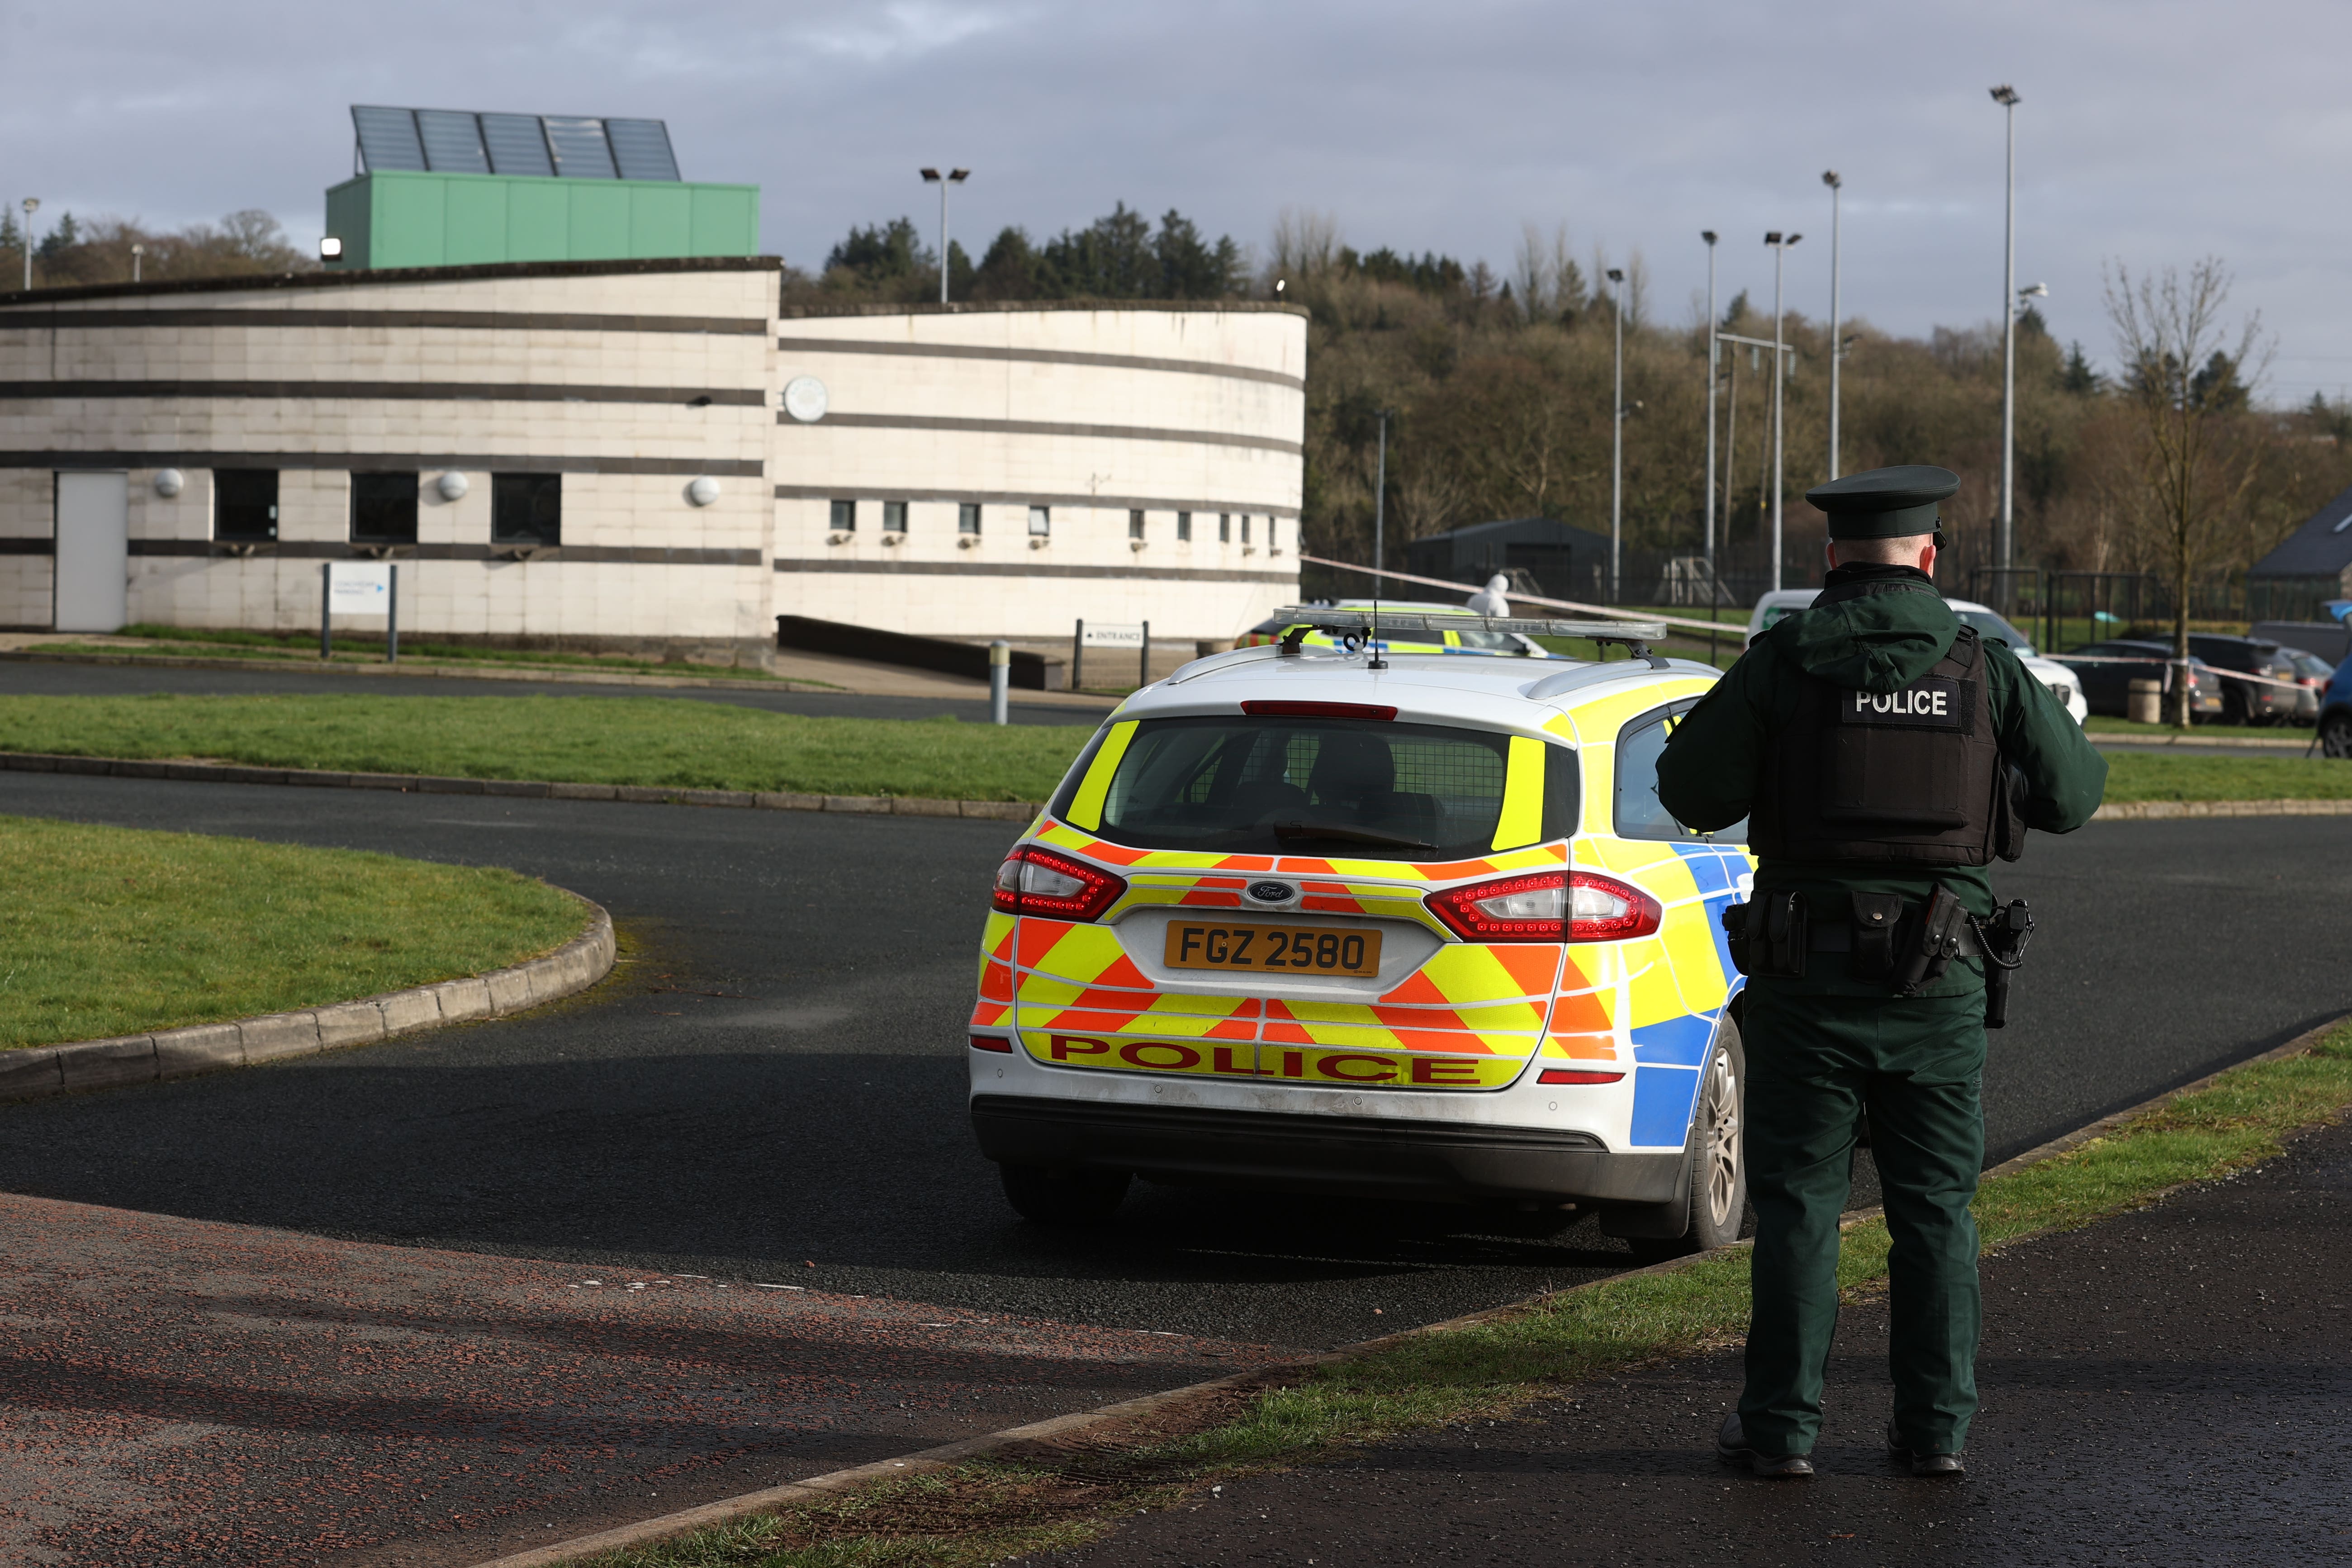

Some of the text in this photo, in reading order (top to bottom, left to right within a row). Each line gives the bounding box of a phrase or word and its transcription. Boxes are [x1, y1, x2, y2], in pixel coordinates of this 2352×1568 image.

[1856, 690, 1947, 715] POLICE
[1257, 886, 1284, 898] Ford
[1180, 927, 1365, 970] FGZ 2580
[1050, 1034, 1480, 1085] POLICE
